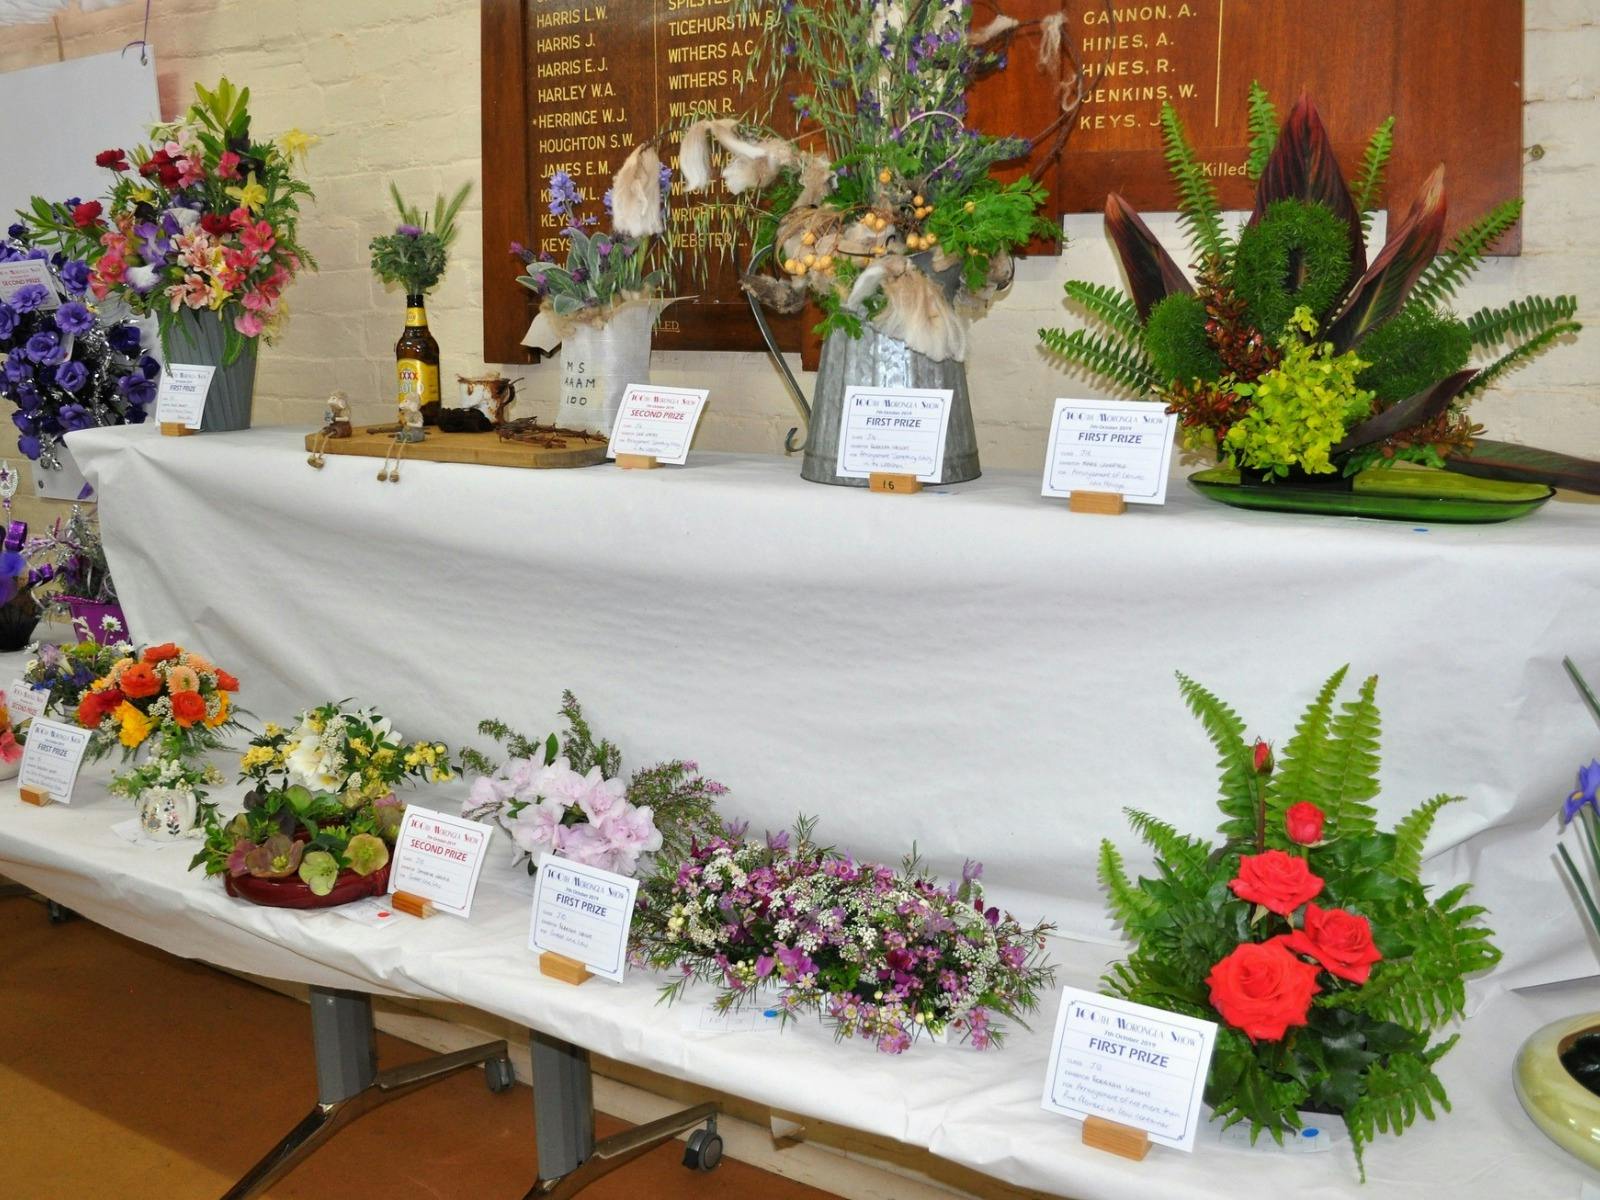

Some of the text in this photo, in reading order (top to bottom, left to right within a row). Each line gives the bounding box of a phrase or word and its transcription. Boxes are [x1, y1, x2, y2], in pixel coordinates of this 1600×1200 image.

[536, 6, 608, 28] HARRIS L.W.
[1177, 4, 1197, 18] A.
[669, 14, 742, 36] TICEHURST
[536, 32, 596, 54] HARRIS J.
[1156, 32, 1175, 46] A.
[668, 43, 728, 63] WITHERS
[537, 57, 608, 78] HARRIS E.J.
[1156, 58, 1176, 73] R.
[668, 70, 728, 90] WITHERS
[538, 83, 616, 103] HARLEY W.A.
[1179, 84, 1198, 98] W.
[602, 108, 628, 124] W.J.
[670, 98, 736, 118] WILSON R.
[539, 132, 635, 154] HOUGHTON S.W.
[540, 160, 612, 178] JAMES E.M.
[1202, 162, 1248, 176] Killed
[672, 206, 716, 222] WRIGHT
[630, 410, 686, 420] SECOND PRIZE
[866, 417, 921, 427] FIRST PRIZE
[1078, 432, 1142, 443] FIRST PRIZE
[37, 742, 52, 753] FIRST
[52, 746, 68, 757] PRIZE
[410, 839, 467, 861] SECOND PRIZE
[556, 893, 579, 908] FIRST
[581, 901, 606, 916] PRIZE
[1089, 1037, 1169, 1068] FIRST PRIZE
